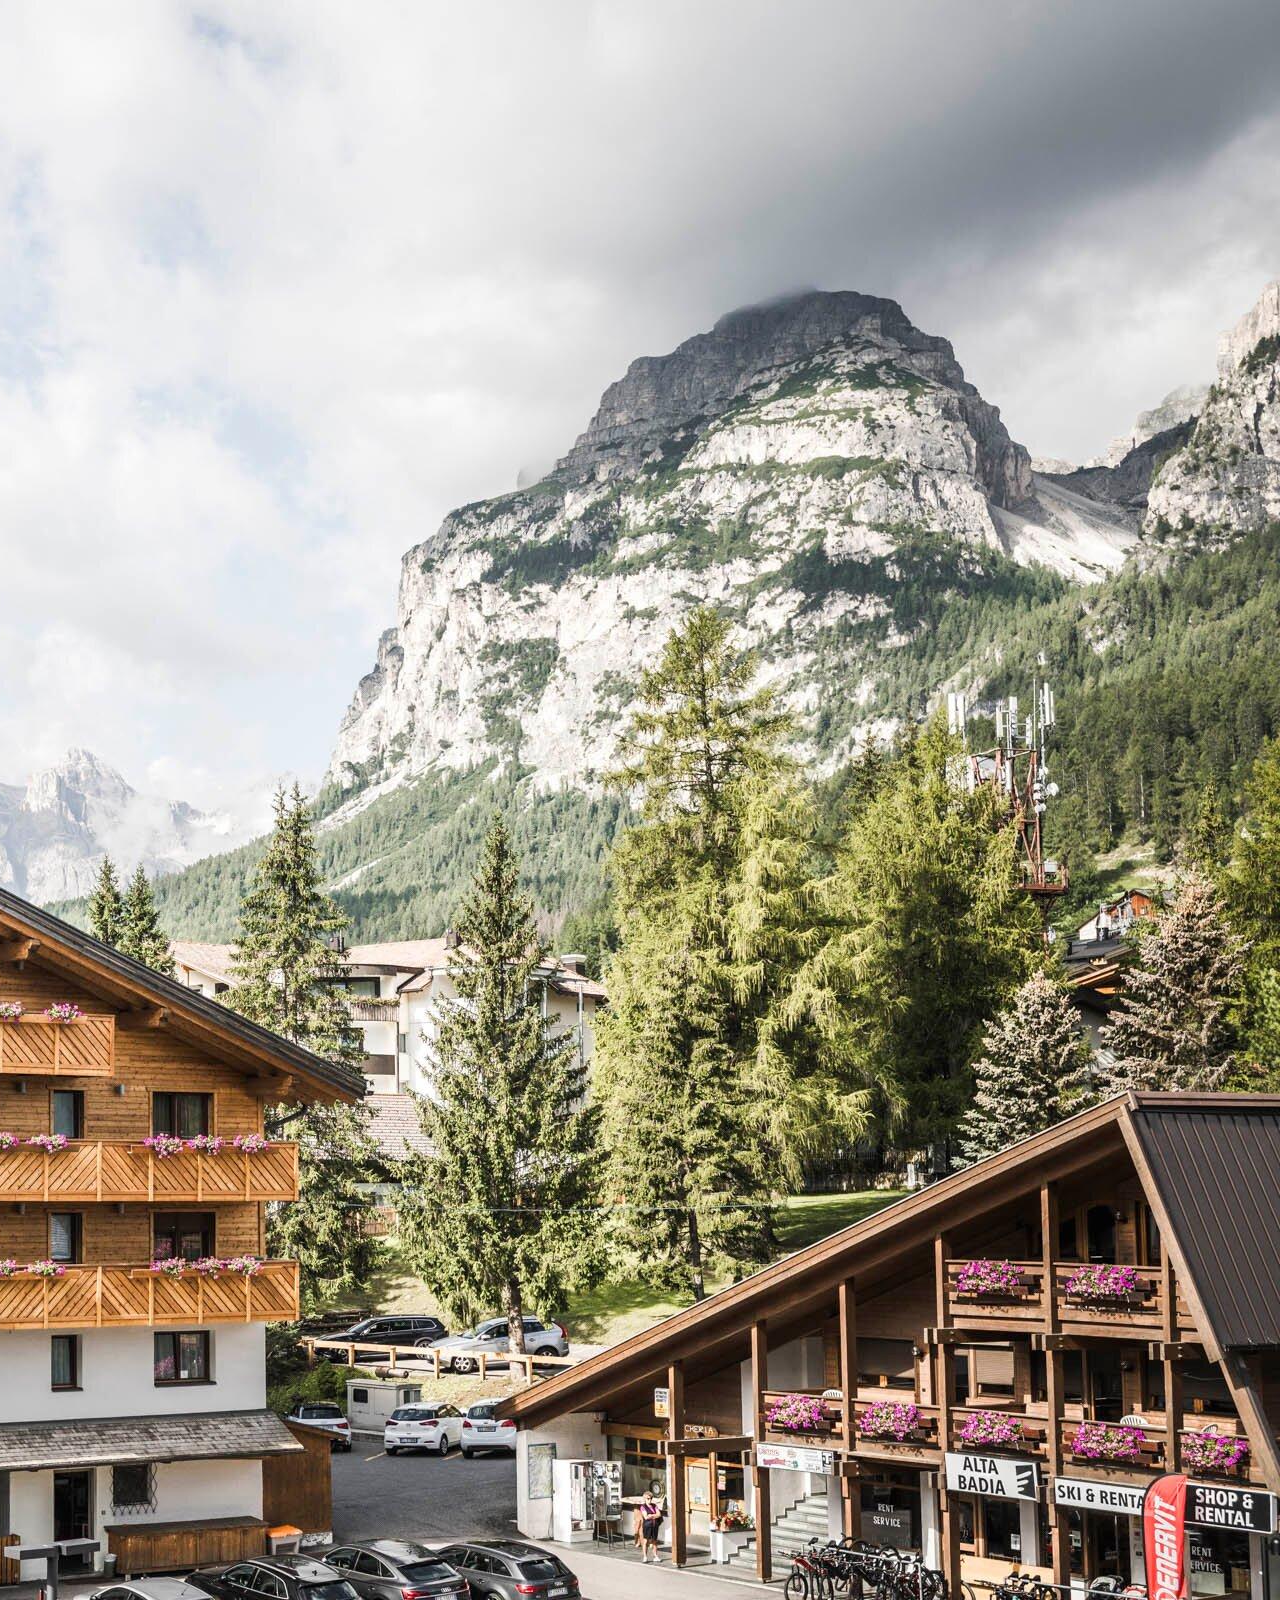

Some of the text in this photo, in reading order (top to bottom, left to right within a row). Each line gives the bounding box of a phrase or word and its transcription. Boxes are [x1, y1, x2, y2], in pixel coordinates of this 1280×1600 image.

[962, 1456, 999, 1475] ALTA
[958, 1475, 1006, 1495] BADIA
[1058, 1484, 1144, 1509] SKI & RENTA
[1195, 1488, 1254, 1509] SHOP &
[877, 1503, 895, 1513] RENT
[1195, 1505, 1254, 1528] RENTAL
[873, 1515, 901, 1528] SERVICE
[1154, 1495, 1180, 1591] ENERVIT
[1191, 1545, 1212, 1558] RENT
[1190, 1560, 1221, 1573] ERVICE
